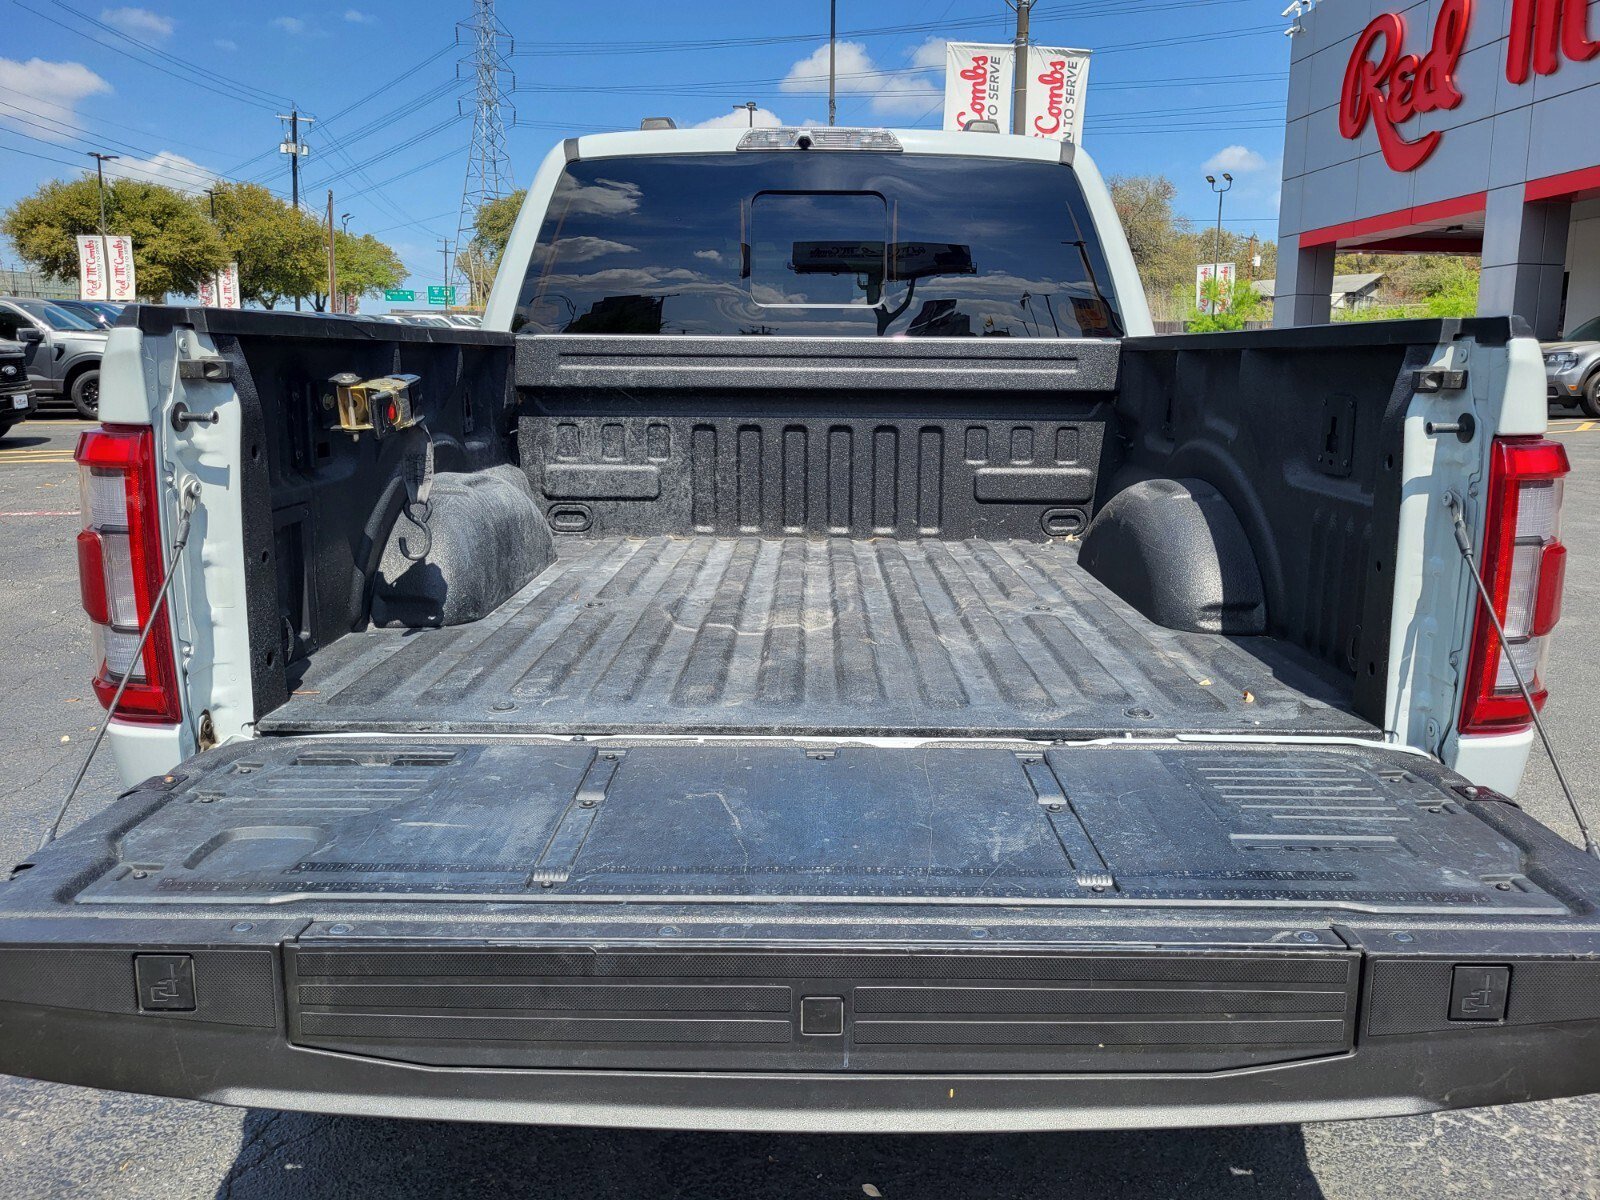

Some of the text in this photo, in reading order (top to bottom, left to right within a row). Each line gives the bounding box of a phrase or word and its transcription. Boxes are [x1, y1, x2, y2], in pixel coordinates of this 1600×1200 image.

[988, 56, 1001, 100] SERVE
[1034, 61, 1066, 138] Combs
[1065, 61, 1078, 104] SERVE
[1339, 0, 1470, 172] Red
[1063, 108, 1075, 128] TO
[84, 240, 101, 296] Red McCombs
[113, 240, 130, 296] Red McCombs
